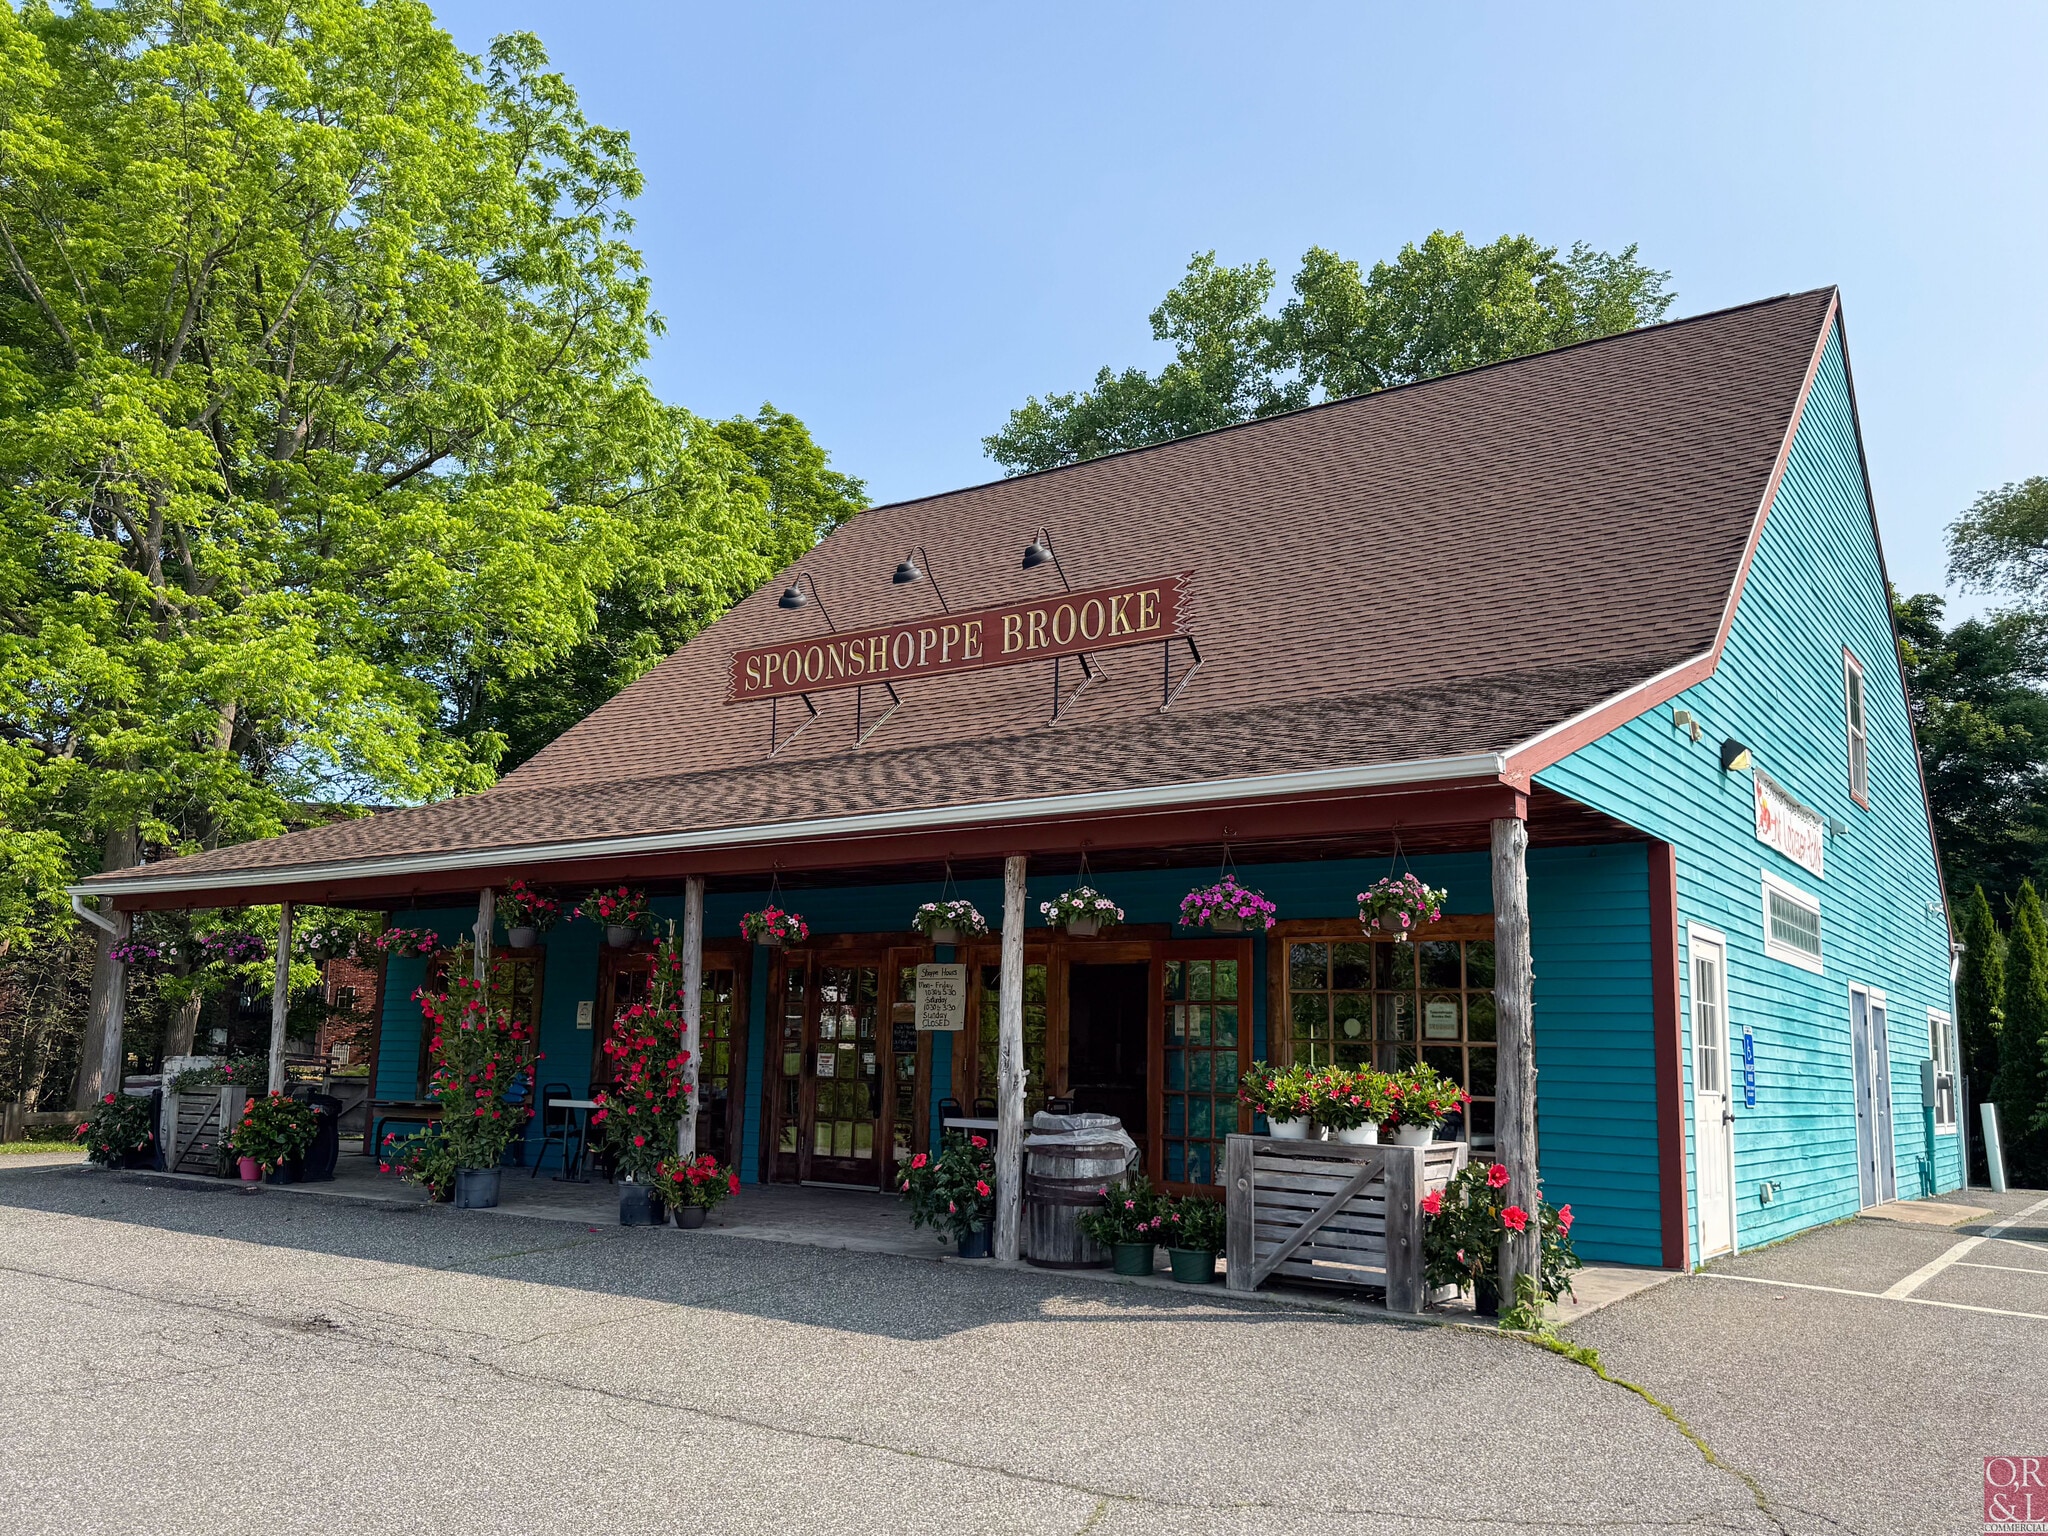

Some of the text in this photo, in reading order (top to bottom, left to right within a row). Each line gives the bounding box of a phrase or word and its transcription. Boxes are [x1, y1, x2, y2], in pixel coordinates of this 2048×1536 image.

[744, 588, 1162, 691] SPOONSHOPPE BROOKE
[921, 967, 958, 978] Shoppe Hours
[935, 981, 954, 991] Friday
[922, 1011, 948, 1019] Sunday
[921, 1018, 950, 1028] CLOSED
